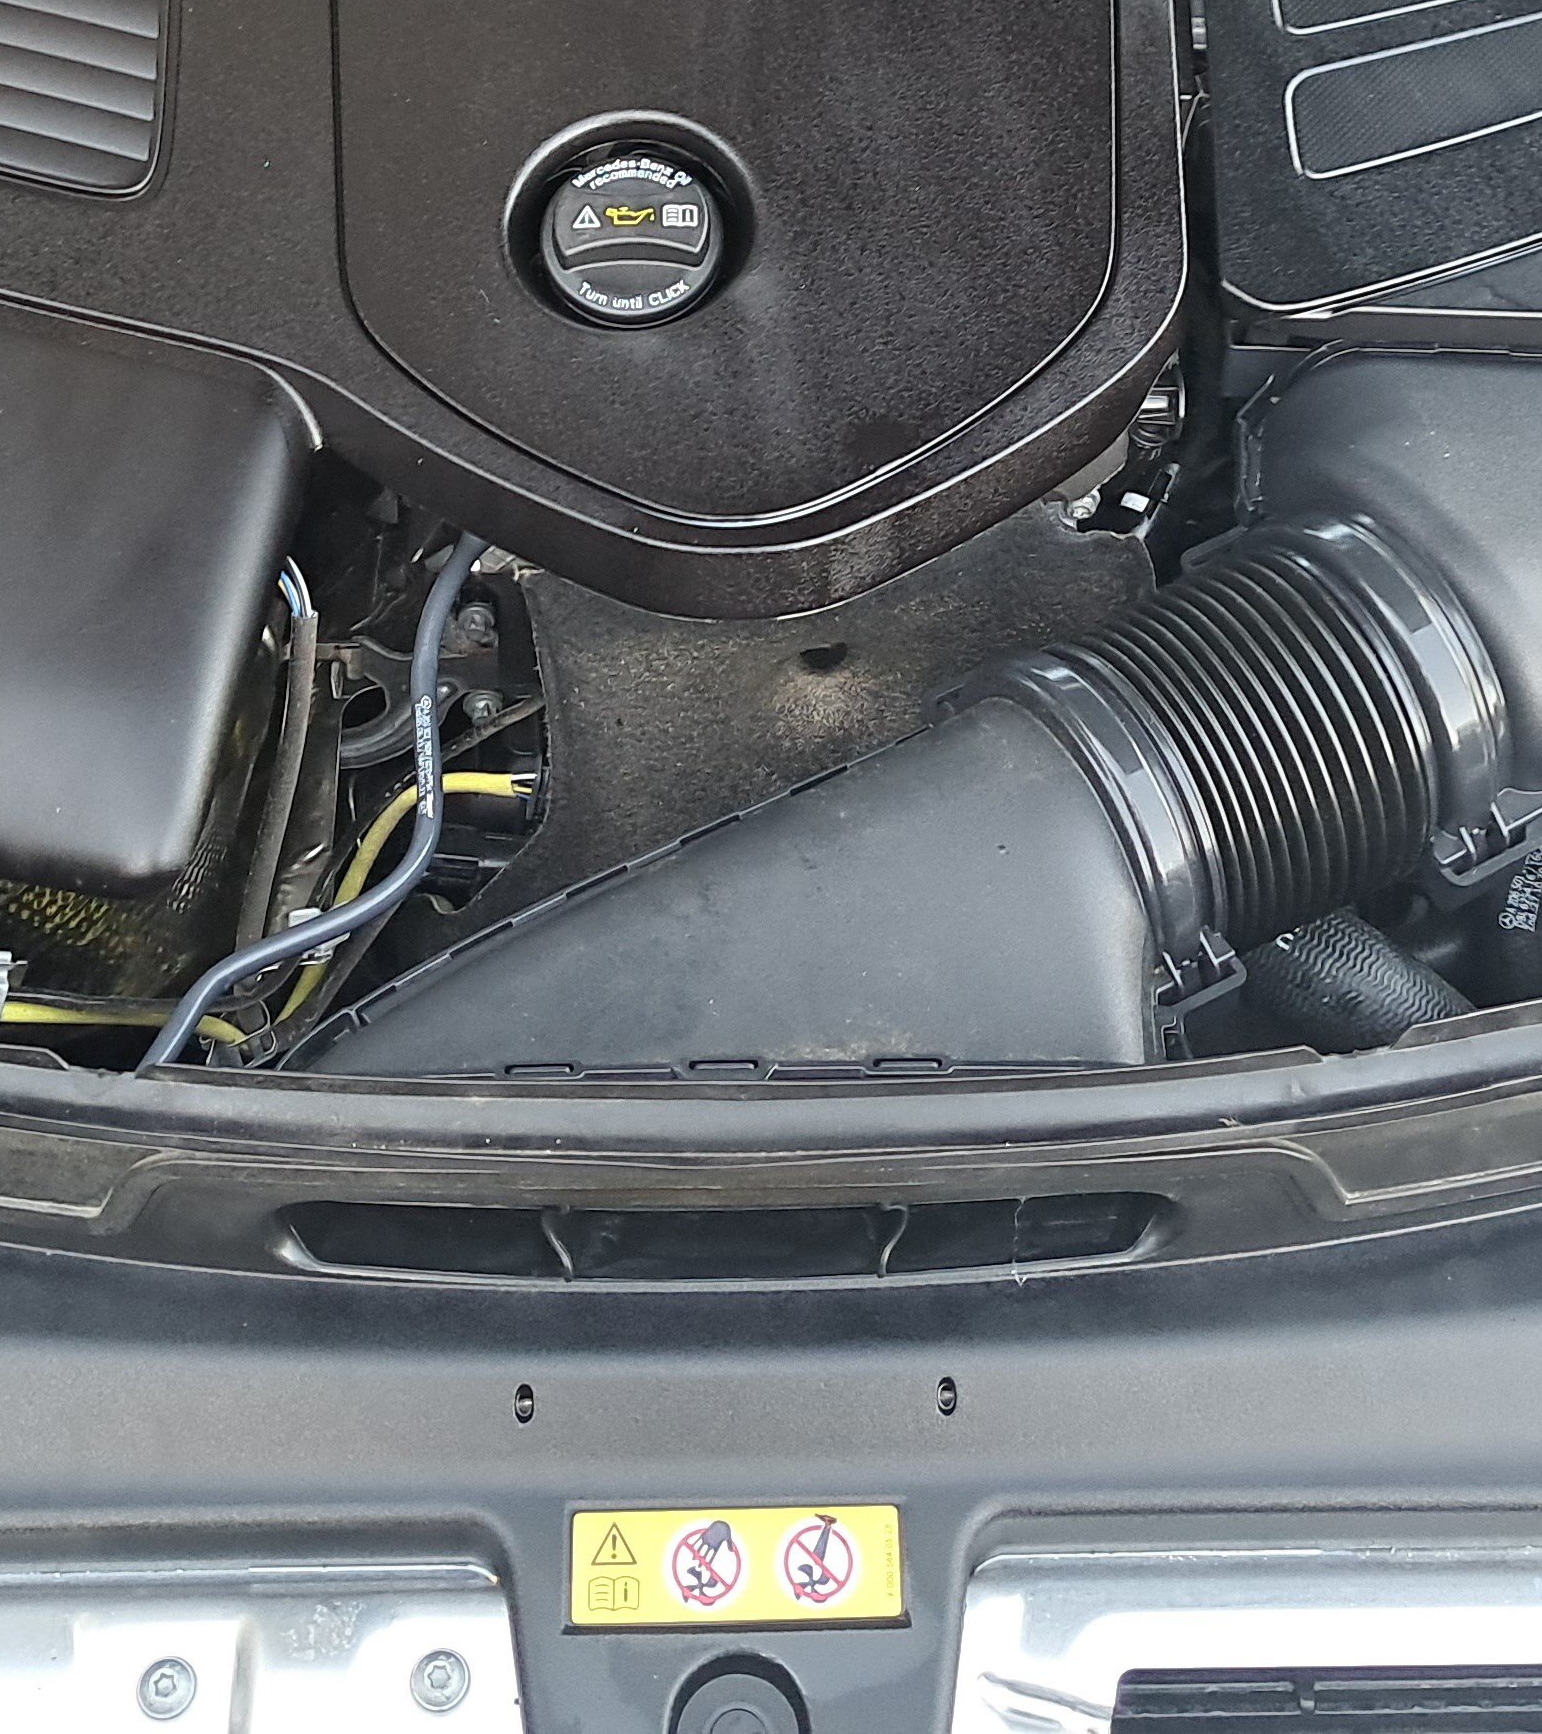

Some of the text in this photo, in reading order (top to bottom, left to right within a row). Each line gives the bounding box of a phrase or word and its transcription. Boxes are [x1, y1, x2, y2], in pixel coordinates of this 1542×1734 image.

[572, 158, 673, 187] Mercedes-Benz
[589, 169, 676, 190] recommended
[578, 279, 690, 310] Turn until CLICK
